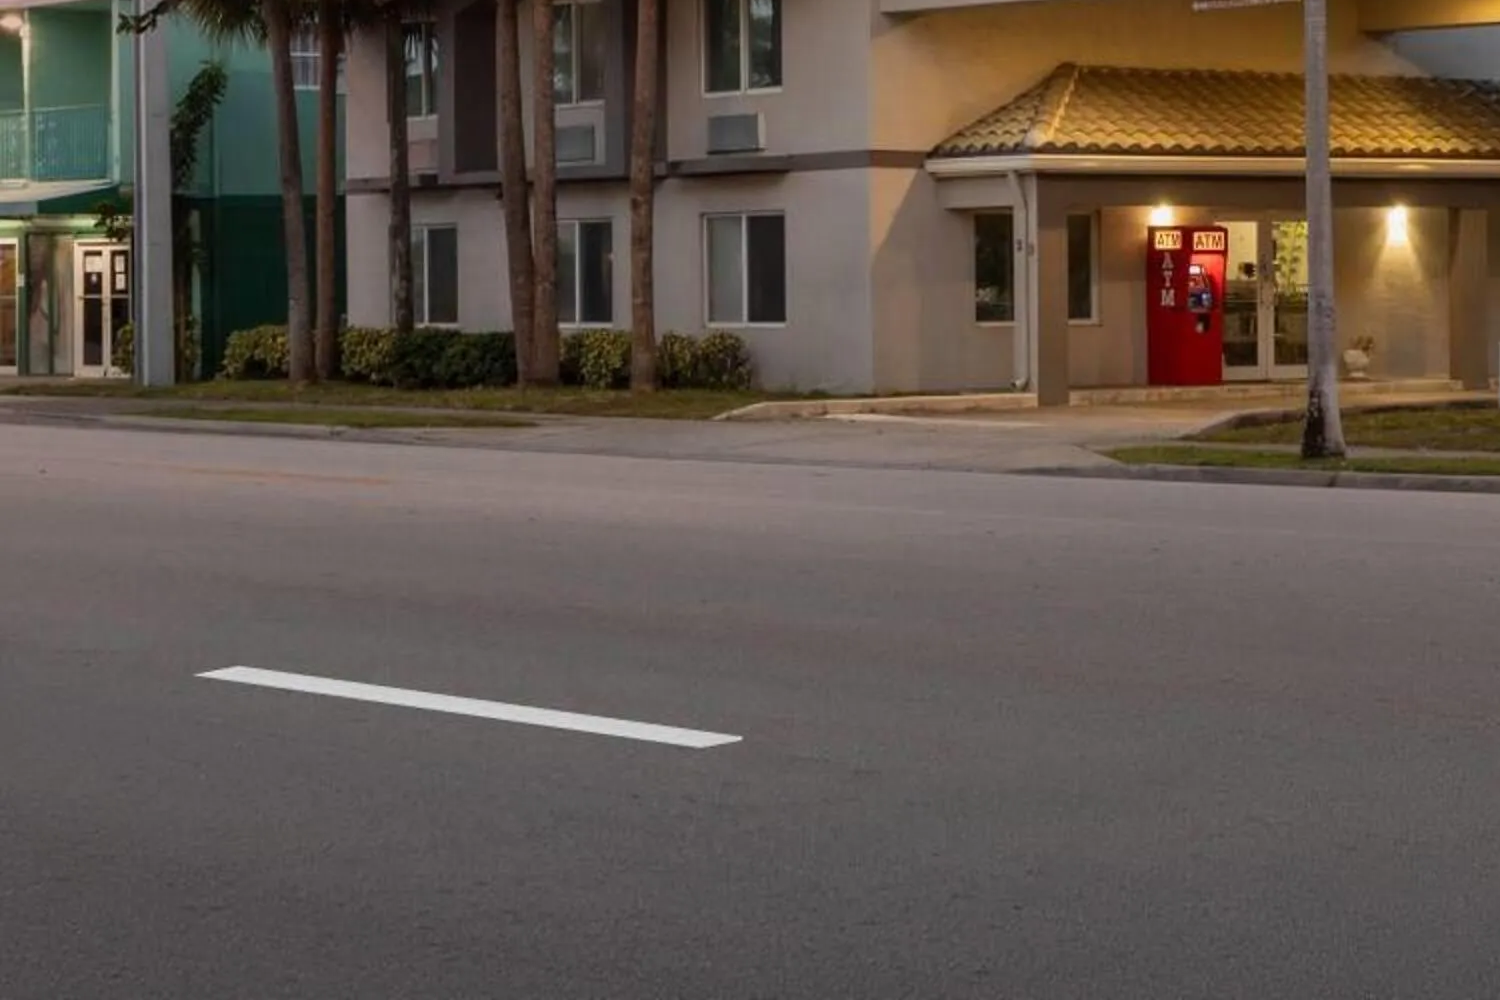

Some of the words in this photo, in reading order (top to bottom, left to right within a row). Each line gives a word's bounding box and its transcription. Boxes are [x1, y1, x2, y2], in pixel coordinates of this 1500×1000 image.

[1157, 233, 1180, 247] ATM
[1195, 233, 1223, 249] ATM
[1161, 252, 1175, 306] ATM
